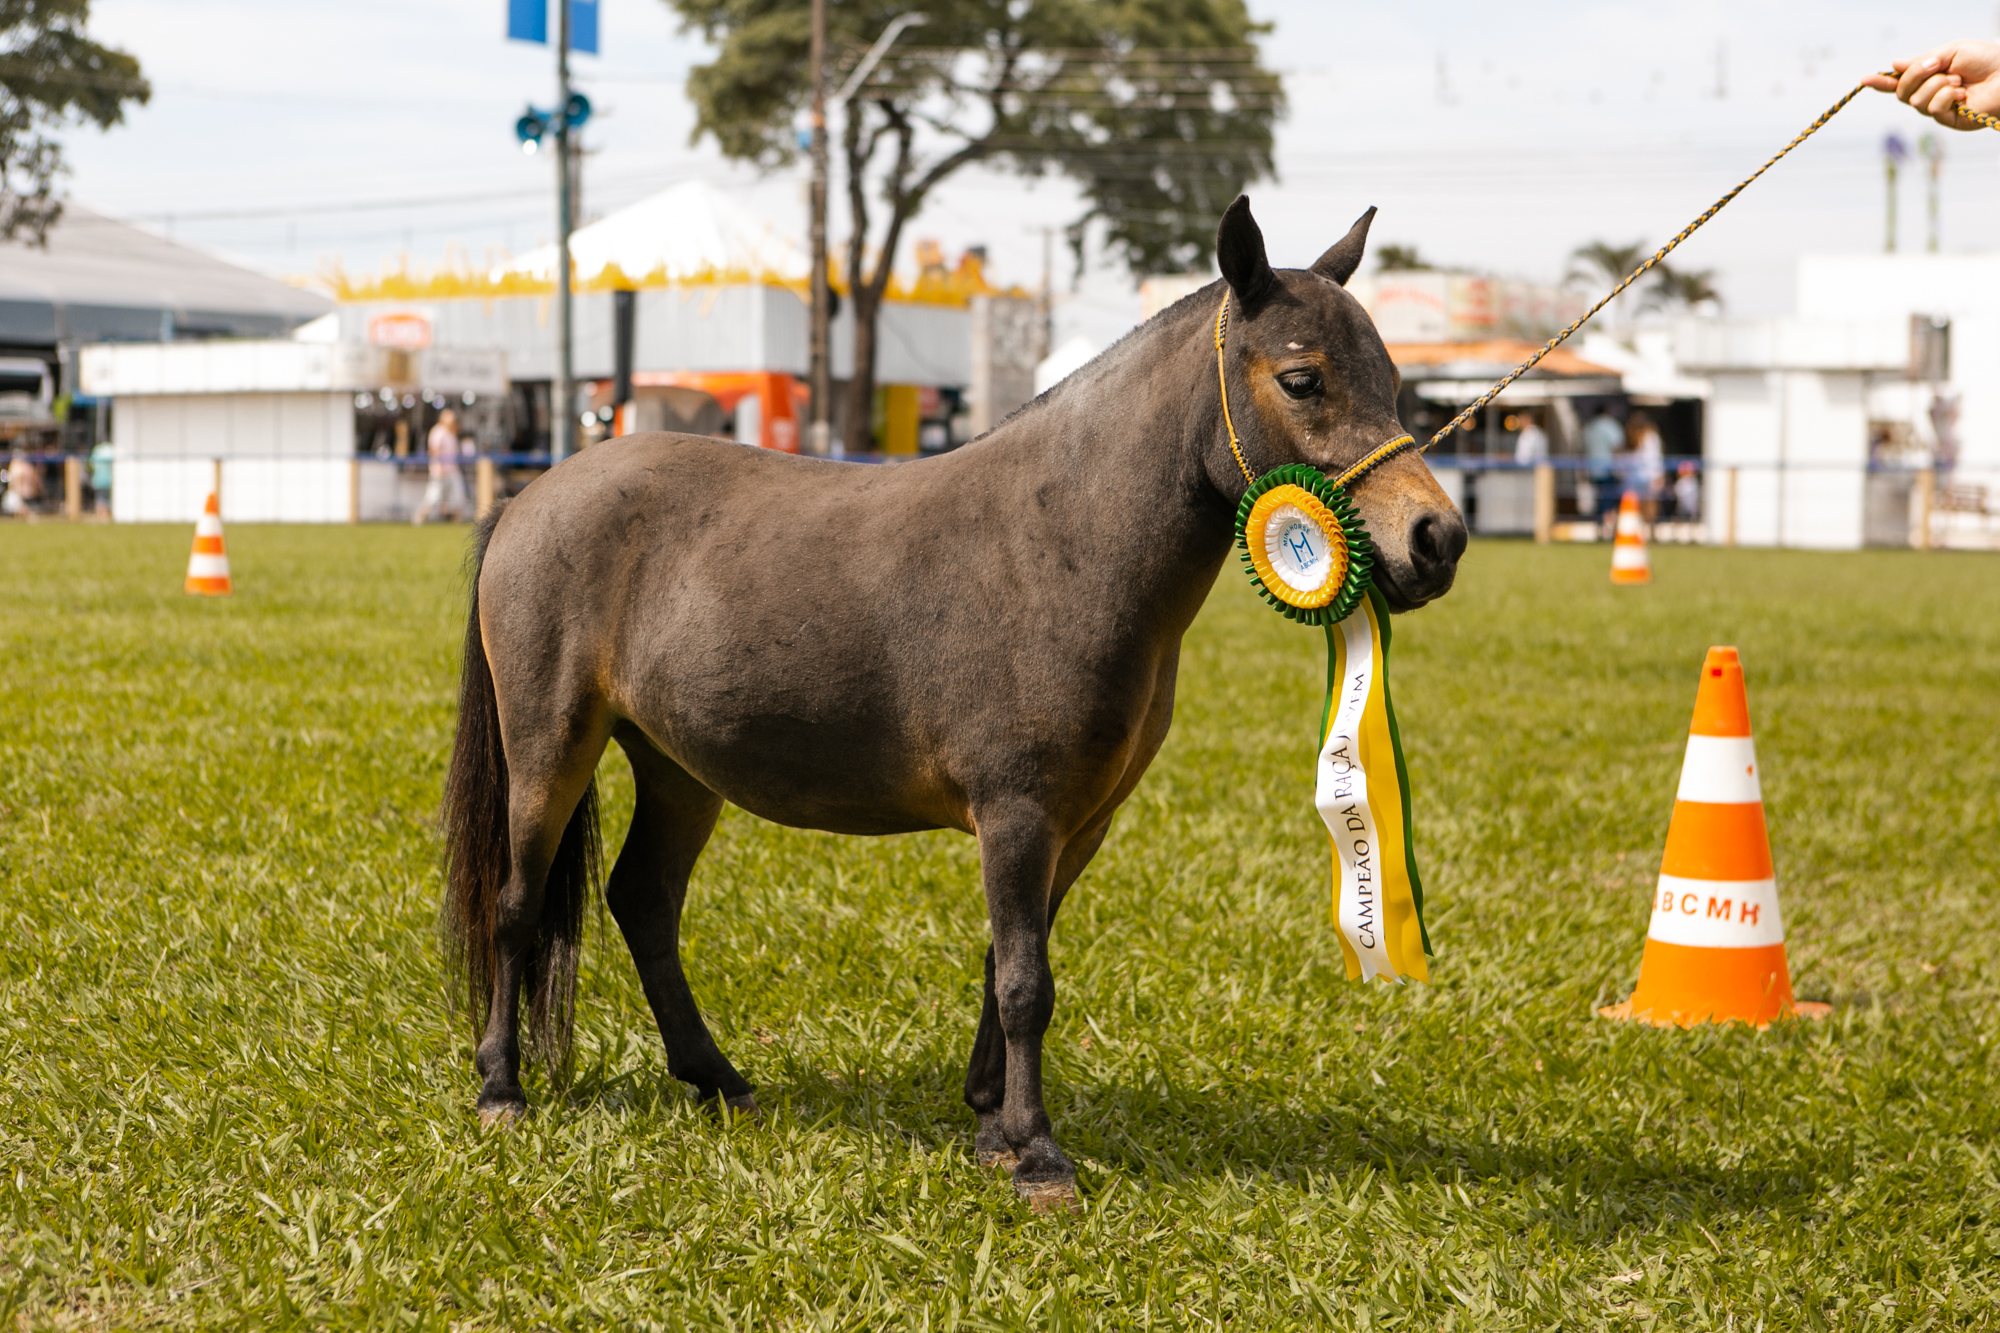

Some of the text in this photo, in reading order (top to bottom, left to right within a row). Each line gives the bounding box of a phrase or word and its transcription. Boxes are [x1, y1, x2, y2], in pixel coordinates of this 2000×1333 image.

[1283, 523, 1310, 547] MINI-HORSE
[1330, 745, 1357, 800] RAÇA
[1340, 802, 1366, 833] DA
[1353, 839, 1376, 950] CAMPEÃO
